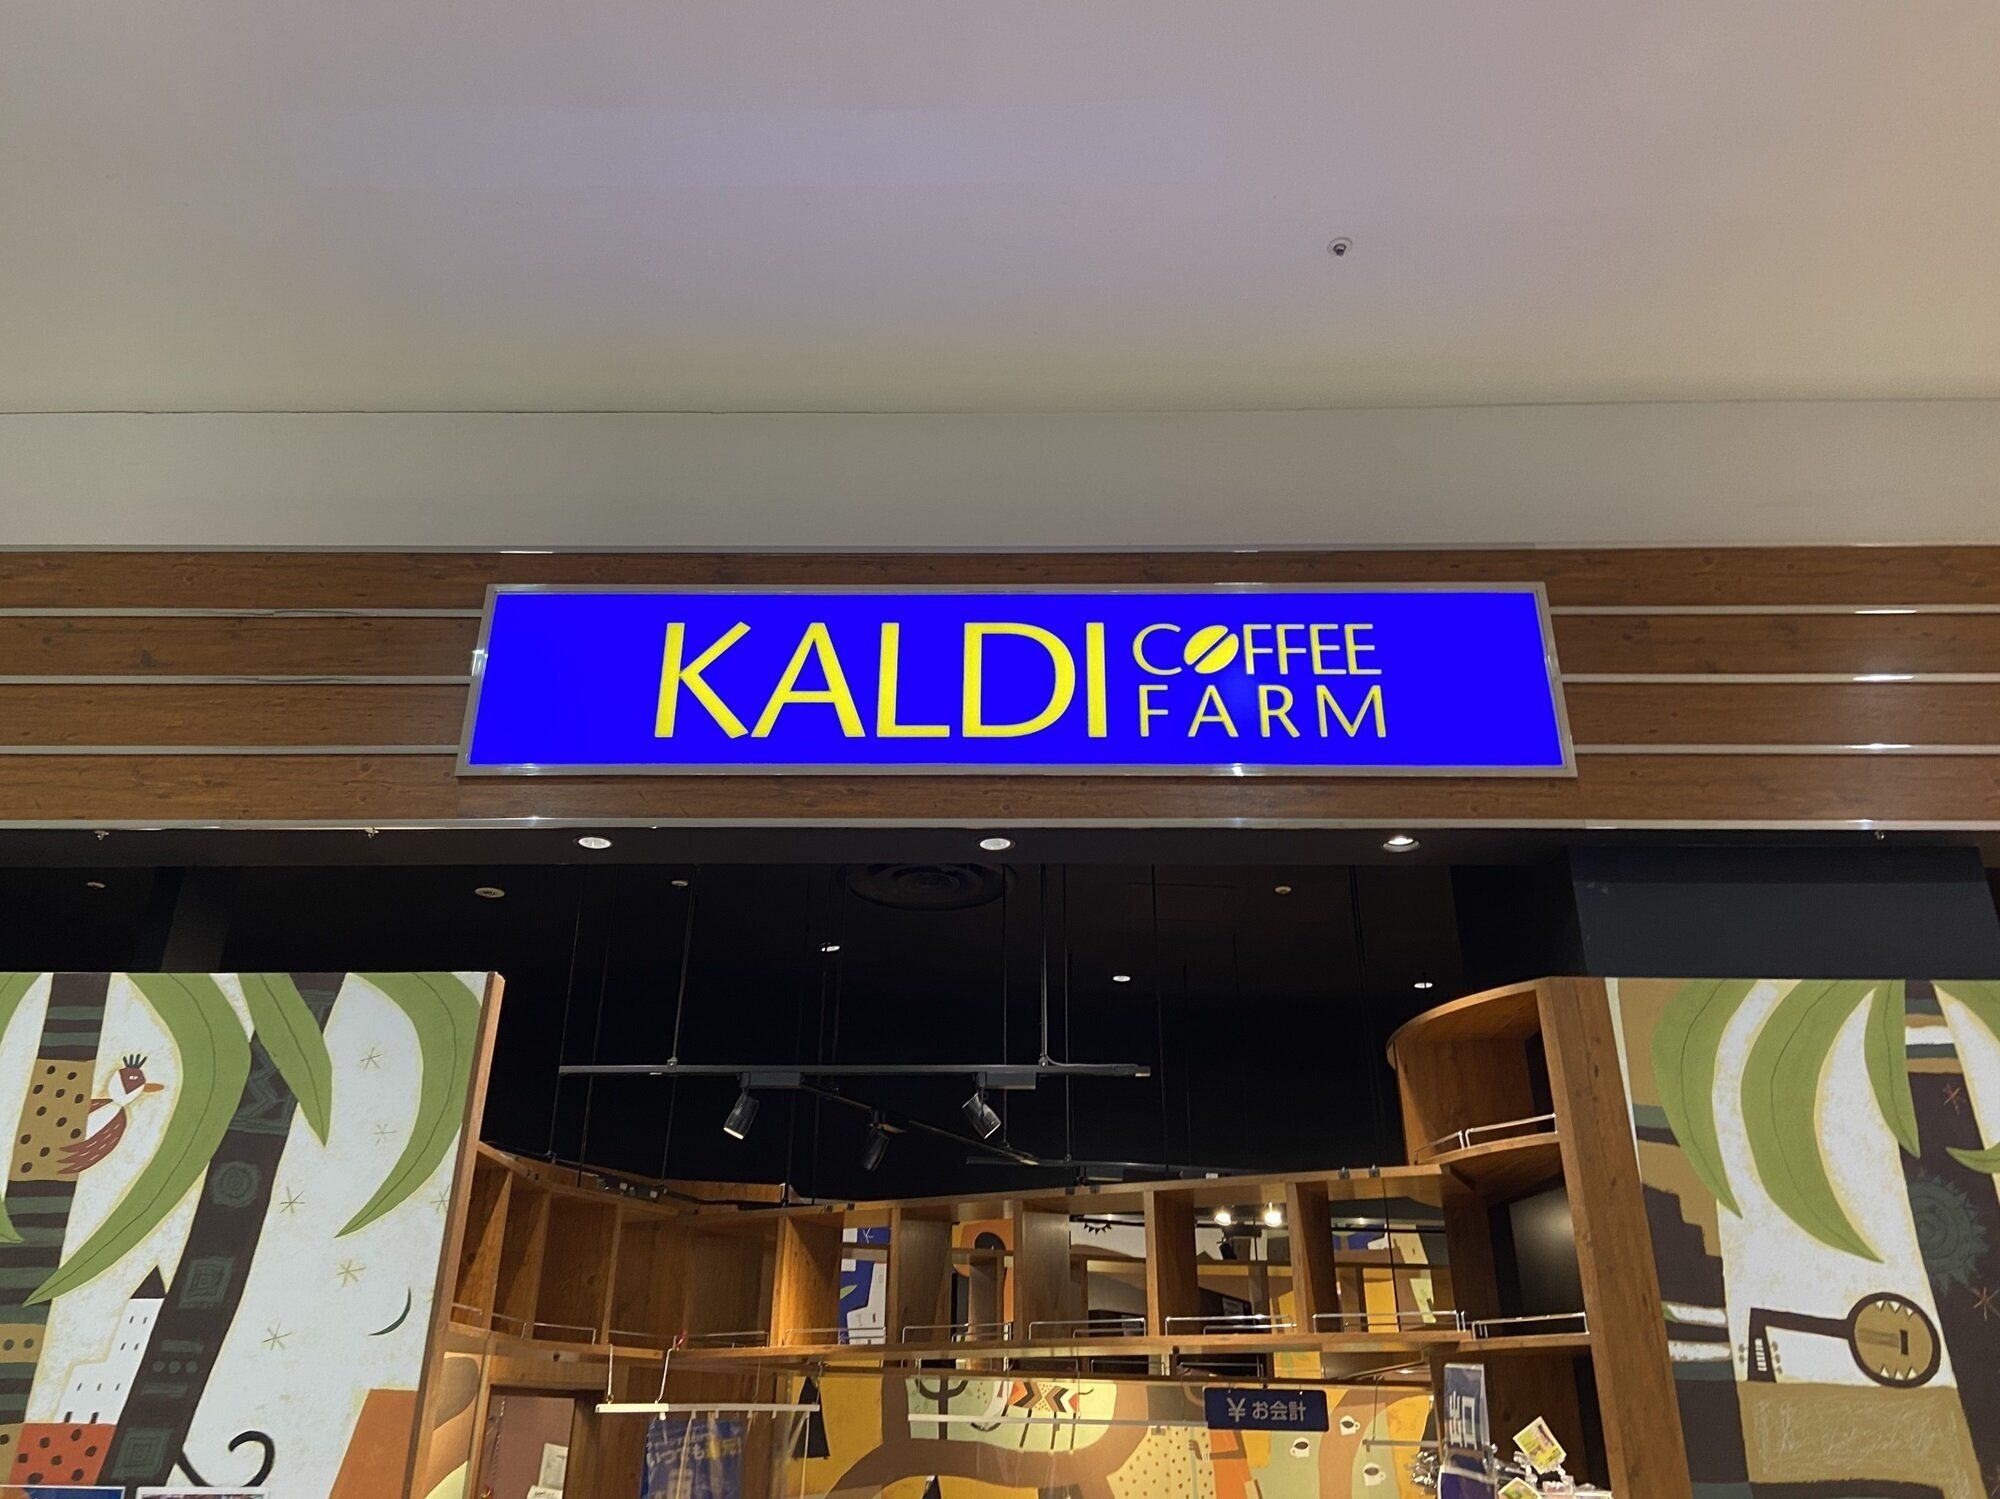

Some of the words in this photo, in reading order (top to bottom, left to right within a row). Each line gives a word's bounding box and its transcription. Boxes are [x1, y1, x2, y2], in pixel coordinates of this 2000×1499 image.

[1132, 623, 1382, 675] COFFEE
[655, 622, 1107, 739] KALDI
[1138, 684, 1387, 738] FARM
[1251, 1400, 1307, 1423] お会計
